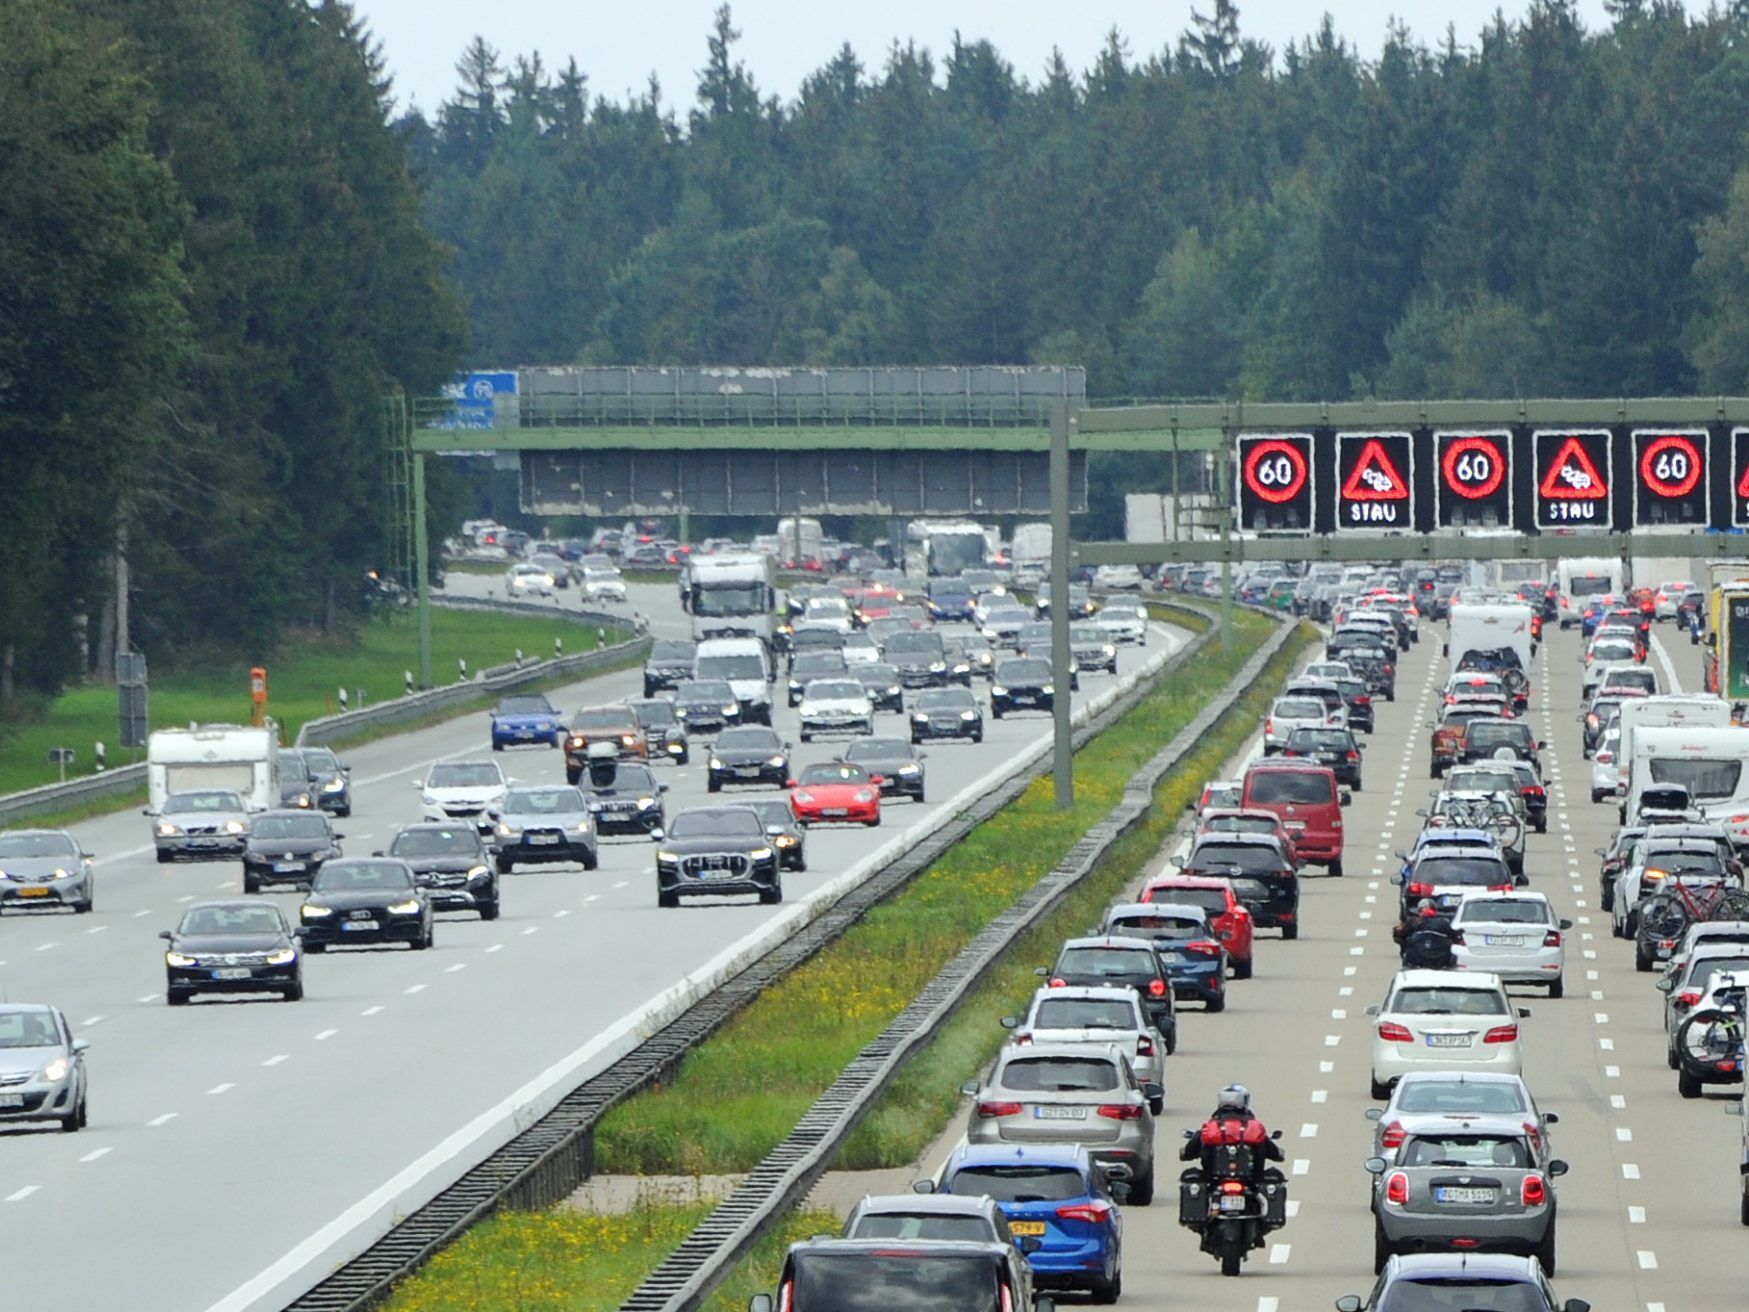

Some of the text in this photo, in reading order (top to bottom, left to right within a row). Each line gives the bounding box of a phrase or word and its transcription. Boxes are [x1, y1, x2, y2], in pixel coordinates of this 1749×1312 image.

[1258, 457, 1292, 484] 60
[1457, 455, 1488, 481] 60
[1655, 453, 1687, 480] 60
[1351, 503, 1397, 522] STAU
[1550, 502, 1594, 520] STAU
